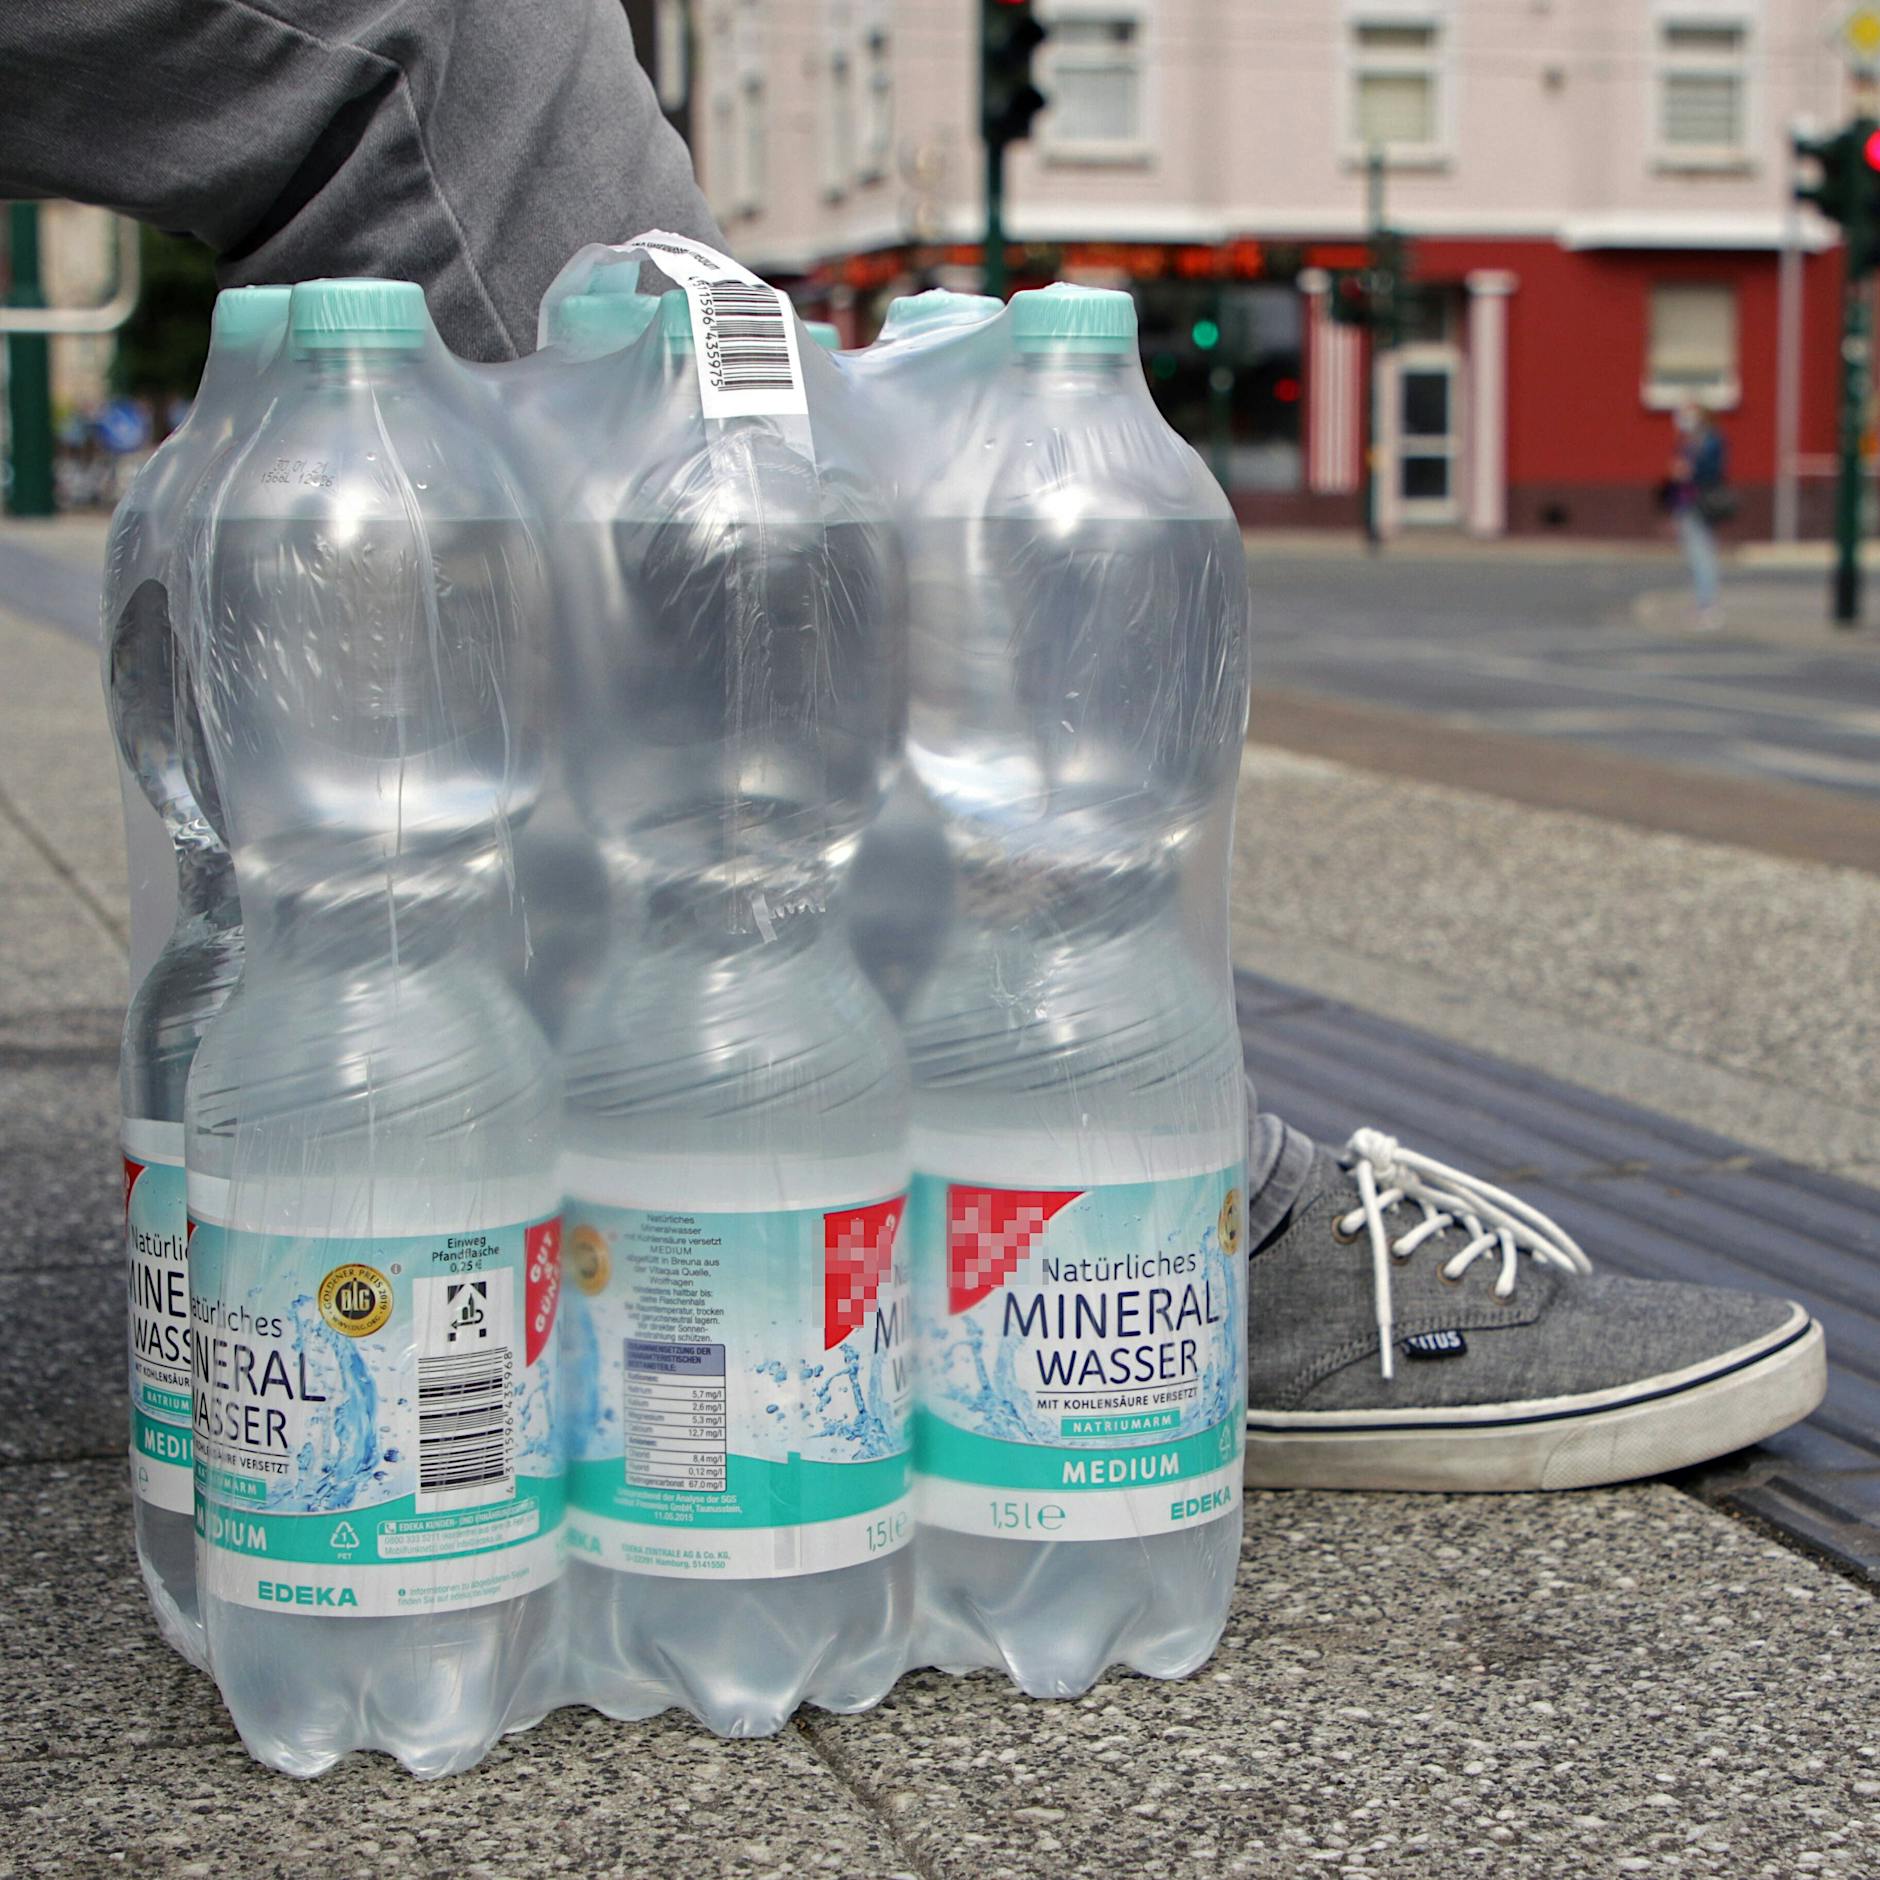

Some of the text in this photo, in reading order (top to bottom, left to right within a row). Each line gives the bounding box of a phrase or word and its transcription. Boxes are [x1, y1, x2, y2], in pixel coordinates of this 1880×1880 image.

[705, 332, 724, 388] 435975
[447, 1236, 487, 1249] Einweg
[688, 1238, 722, 1246] versetzt
[431, 1246, 500, 1261] Pfandflasche
[650, 1246, 692, 1256] MEDIUM
[671, 1257, 702, 1267] Breuna
[703, 1259, 720, 1267] aus
[1045, 1251, 1196, 1283] Natürliches
[323, 1268, 355, 1310] GOLDENER
[696, 1308, 724, 1316] trocken
[1003, 1280, 1219, 1340] MINERAL
[696, 1347, 711, 1356] DER
[1036, 1338, 1198, 1386] WASSER
[503, 1351, 513, 1408] 435968
[692, 1390, 704, 1399] 5,7
[705, 1390, 722, 1400] mg/l
[1037, 1387, 1198, 1410] MIT KOHLENSÄURE VERSETZT
[692, 1403, 704, 1412] 2,6
[705, 1403, 722, 1412] mg/l
[692, 1416, 704, 1425] 5,3
[705, 1416, 722, 1426] mg/l
[1073, 1414, 1172, 1433] NATRIUMARM
[688, 1429, 704, 1438] 12,7
[705, 1429, 723, 1439] mg/l
[504, 1417, 514, 1473] 311596
[239, 1457, 290, 1475] VERSETZT
[693, 1455, 705, 1463] 8,4
[706, 1455, 723, 1464] mg/l
[688, 1468, 705, 1477] 0,12
[706, 1468, 723, 1478] mg/l
[1062, 1452, 1179, 1484] MEDIUM
[688, 1481, 705, 1489] 67,0
[706, 1481, 723, 1490] mg/l
[1171, 1485, 1231, 1520] EDEKA
[258, 1580, 359, 1607] EDEKA
